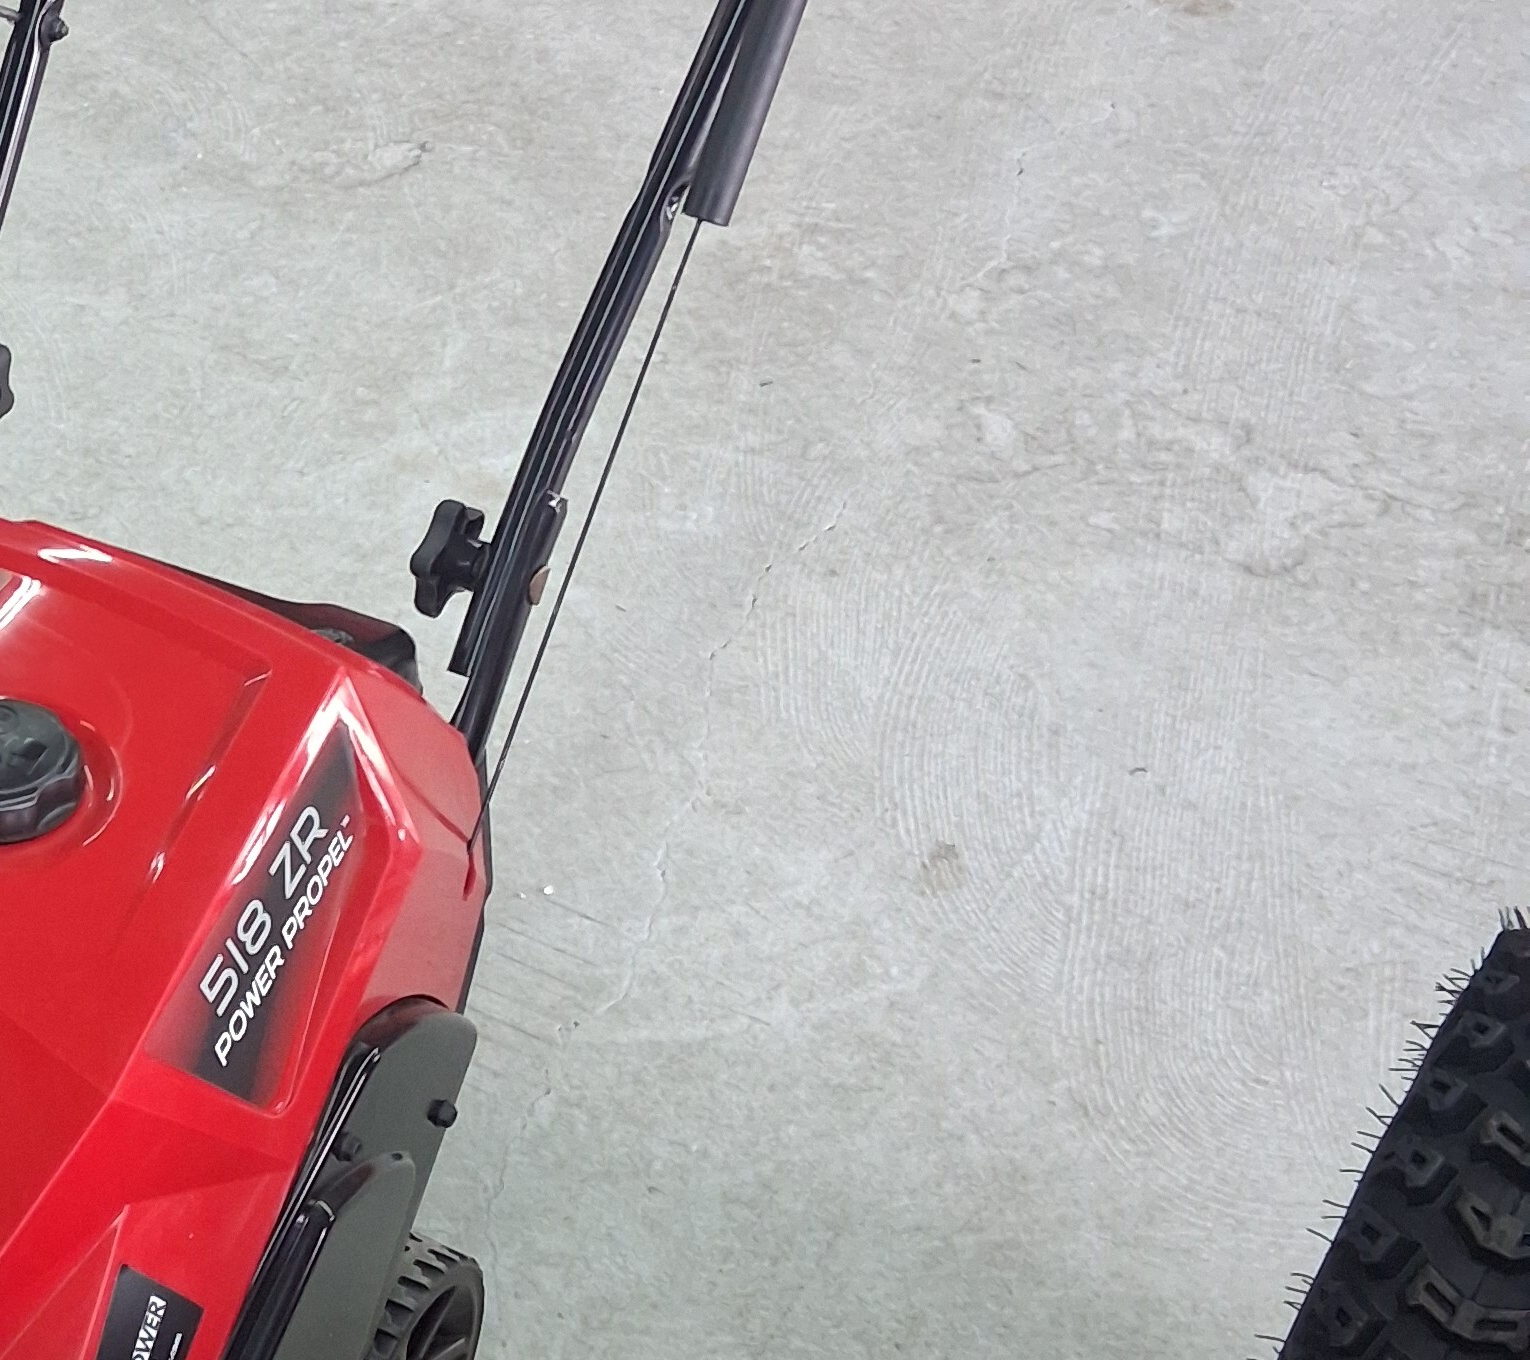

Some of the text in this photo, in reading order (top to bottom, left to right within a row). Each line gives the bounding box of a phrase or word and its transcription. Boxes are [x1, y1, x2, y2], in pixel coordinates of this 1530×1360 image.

[199, 806, 329, 1016] 518 ZR
[214, 829, 353, 1066] POWER PROPEL
